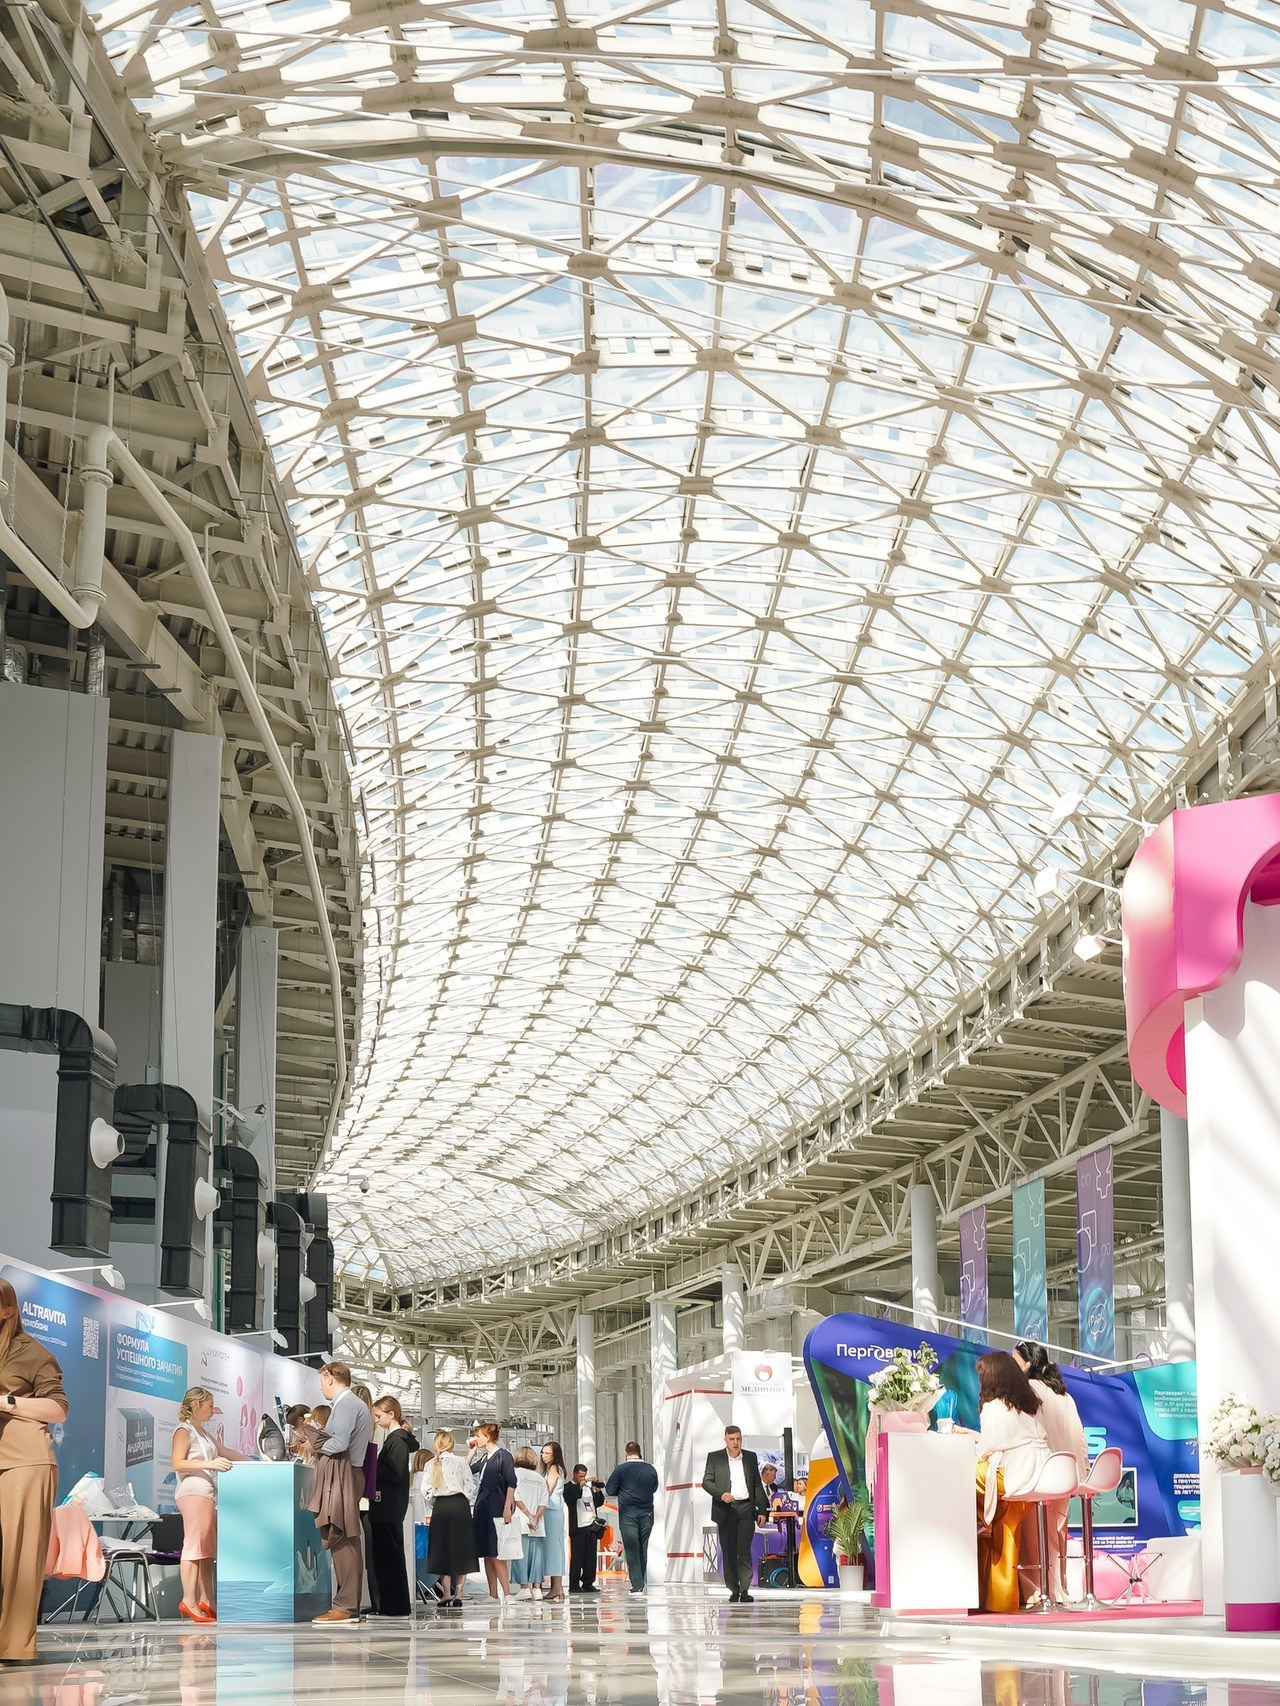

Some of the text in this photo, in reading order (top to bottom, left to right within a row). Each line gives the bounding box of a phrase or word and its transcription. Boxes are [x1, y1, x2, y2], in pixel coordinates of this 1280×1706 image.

[22, 1301, 67, 1327] ALTRAVITA
[116, 1332, 150, 1353] ФОРМУЛА
[116, 1347, 183, 1377] УСПЕШНОГО ЗАЧАТИЯ
